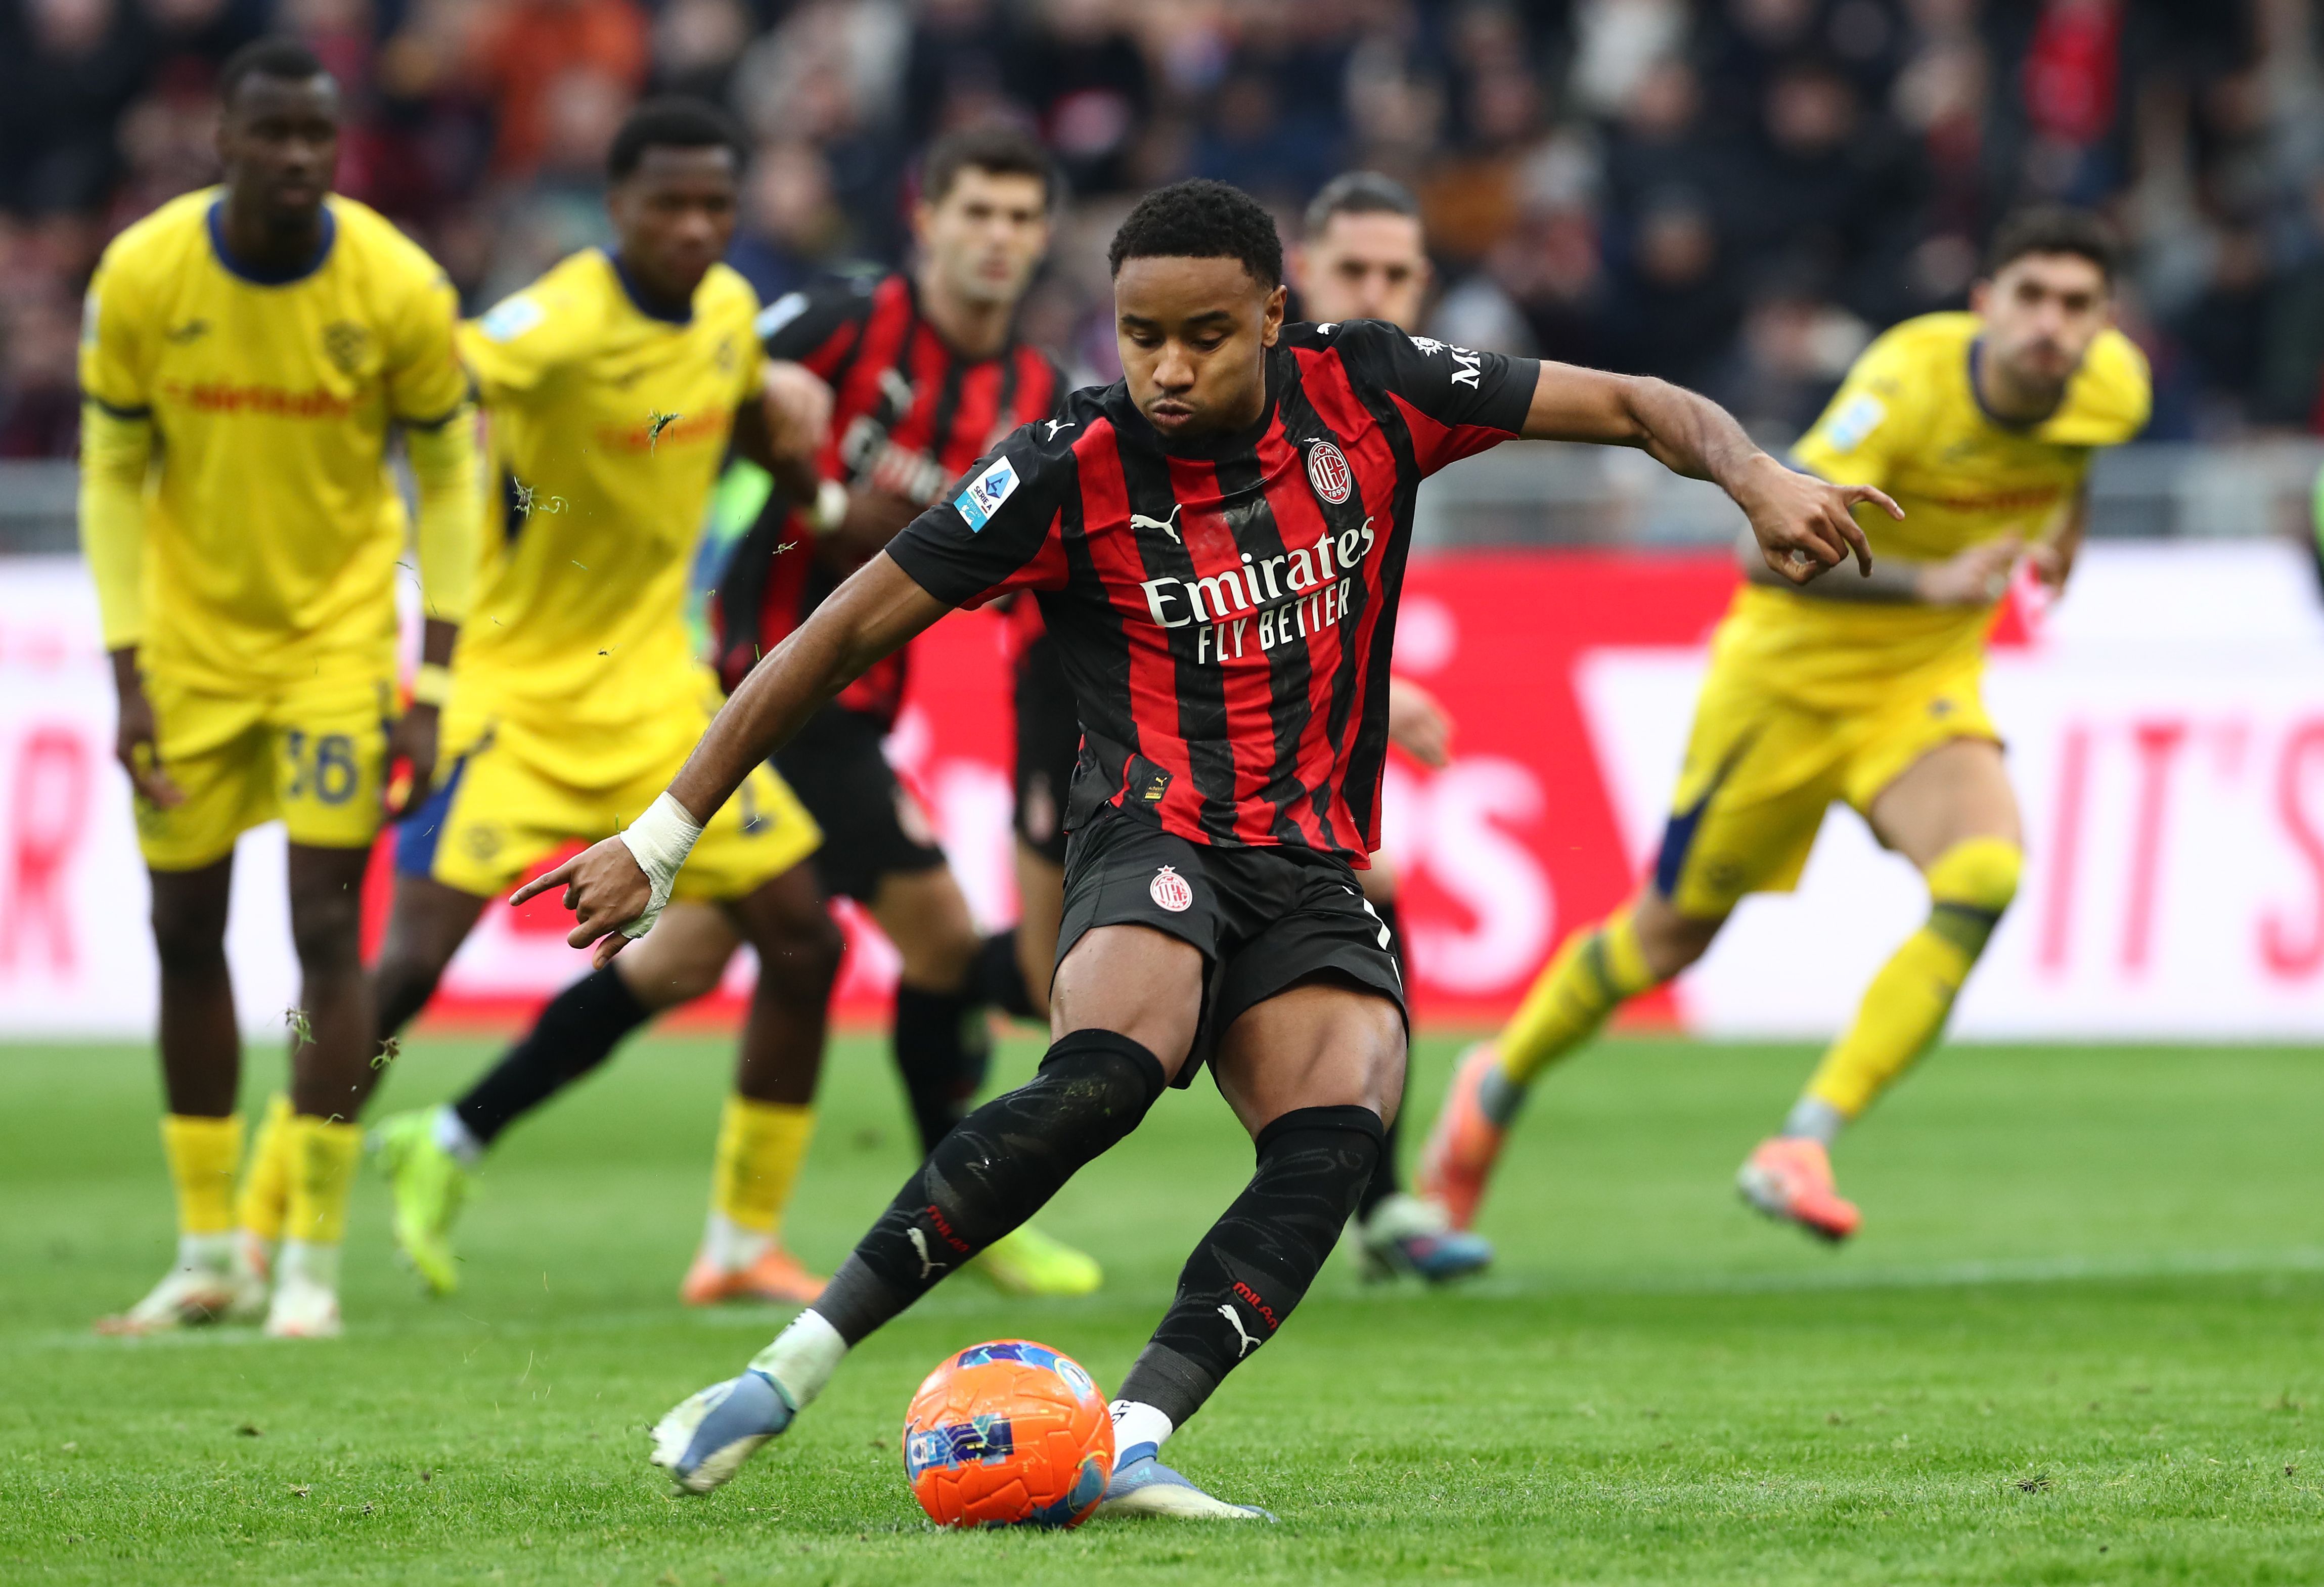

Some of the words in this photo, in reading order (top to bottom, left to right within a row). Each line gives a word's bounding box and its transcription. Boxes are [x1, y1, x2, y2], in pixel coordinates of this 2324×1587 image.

[1314, 447, 1333, 463] ACM
[973, 486, 990, 505] SERIE
[1328, 486, 1346, 498] 1899
[1139, 515, 1374, 628] Emirates
[1198, 616, 1248, 665] FLY
[1259, 577, 1351, 651] BETTER
